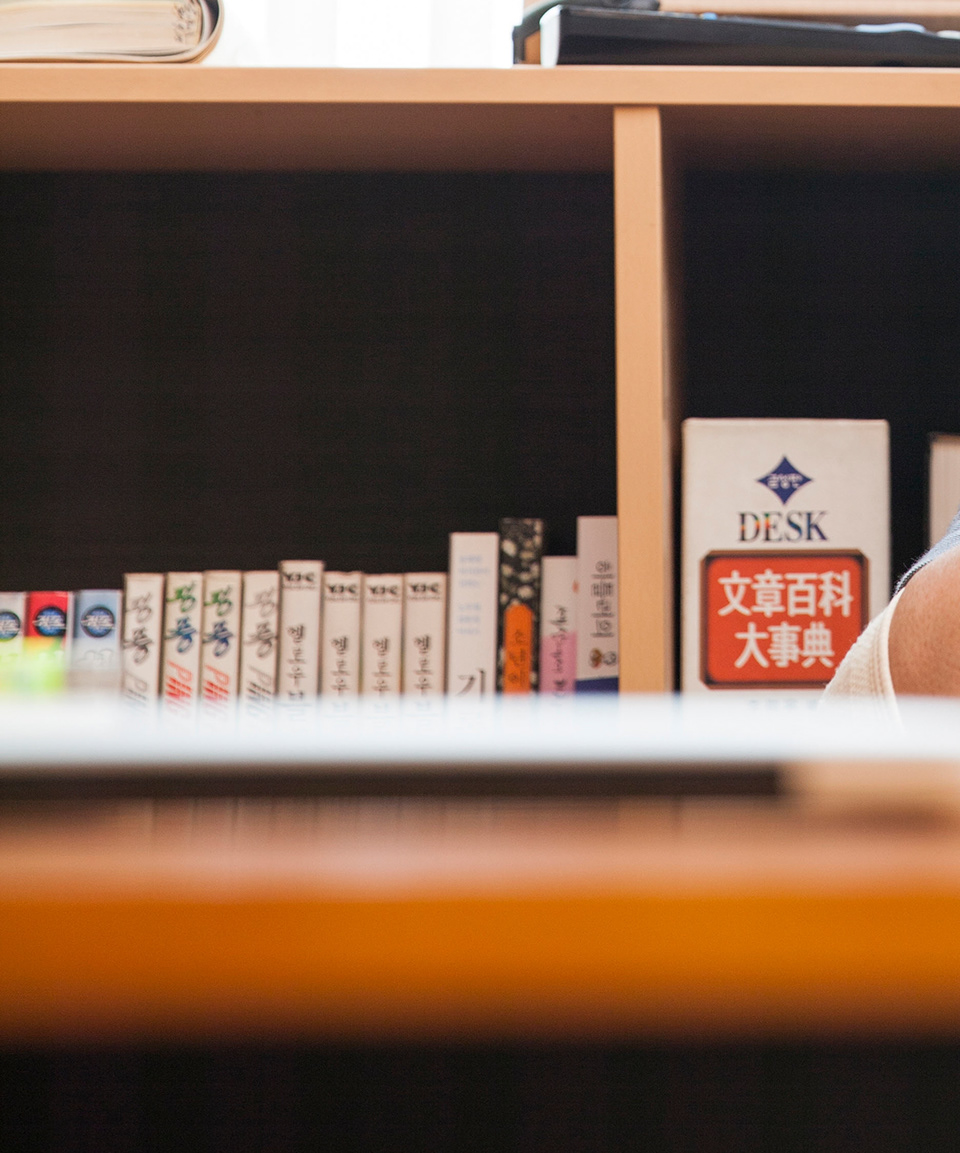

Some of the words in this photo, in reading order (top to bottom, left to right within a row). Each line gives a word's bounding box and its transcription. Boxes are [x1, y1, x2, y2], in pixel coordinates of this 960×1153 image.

[738, 510, 828, 542] DESK
[717, 569, 854, 618] 文章百科
[734, 621, 835, 668] 大事典
